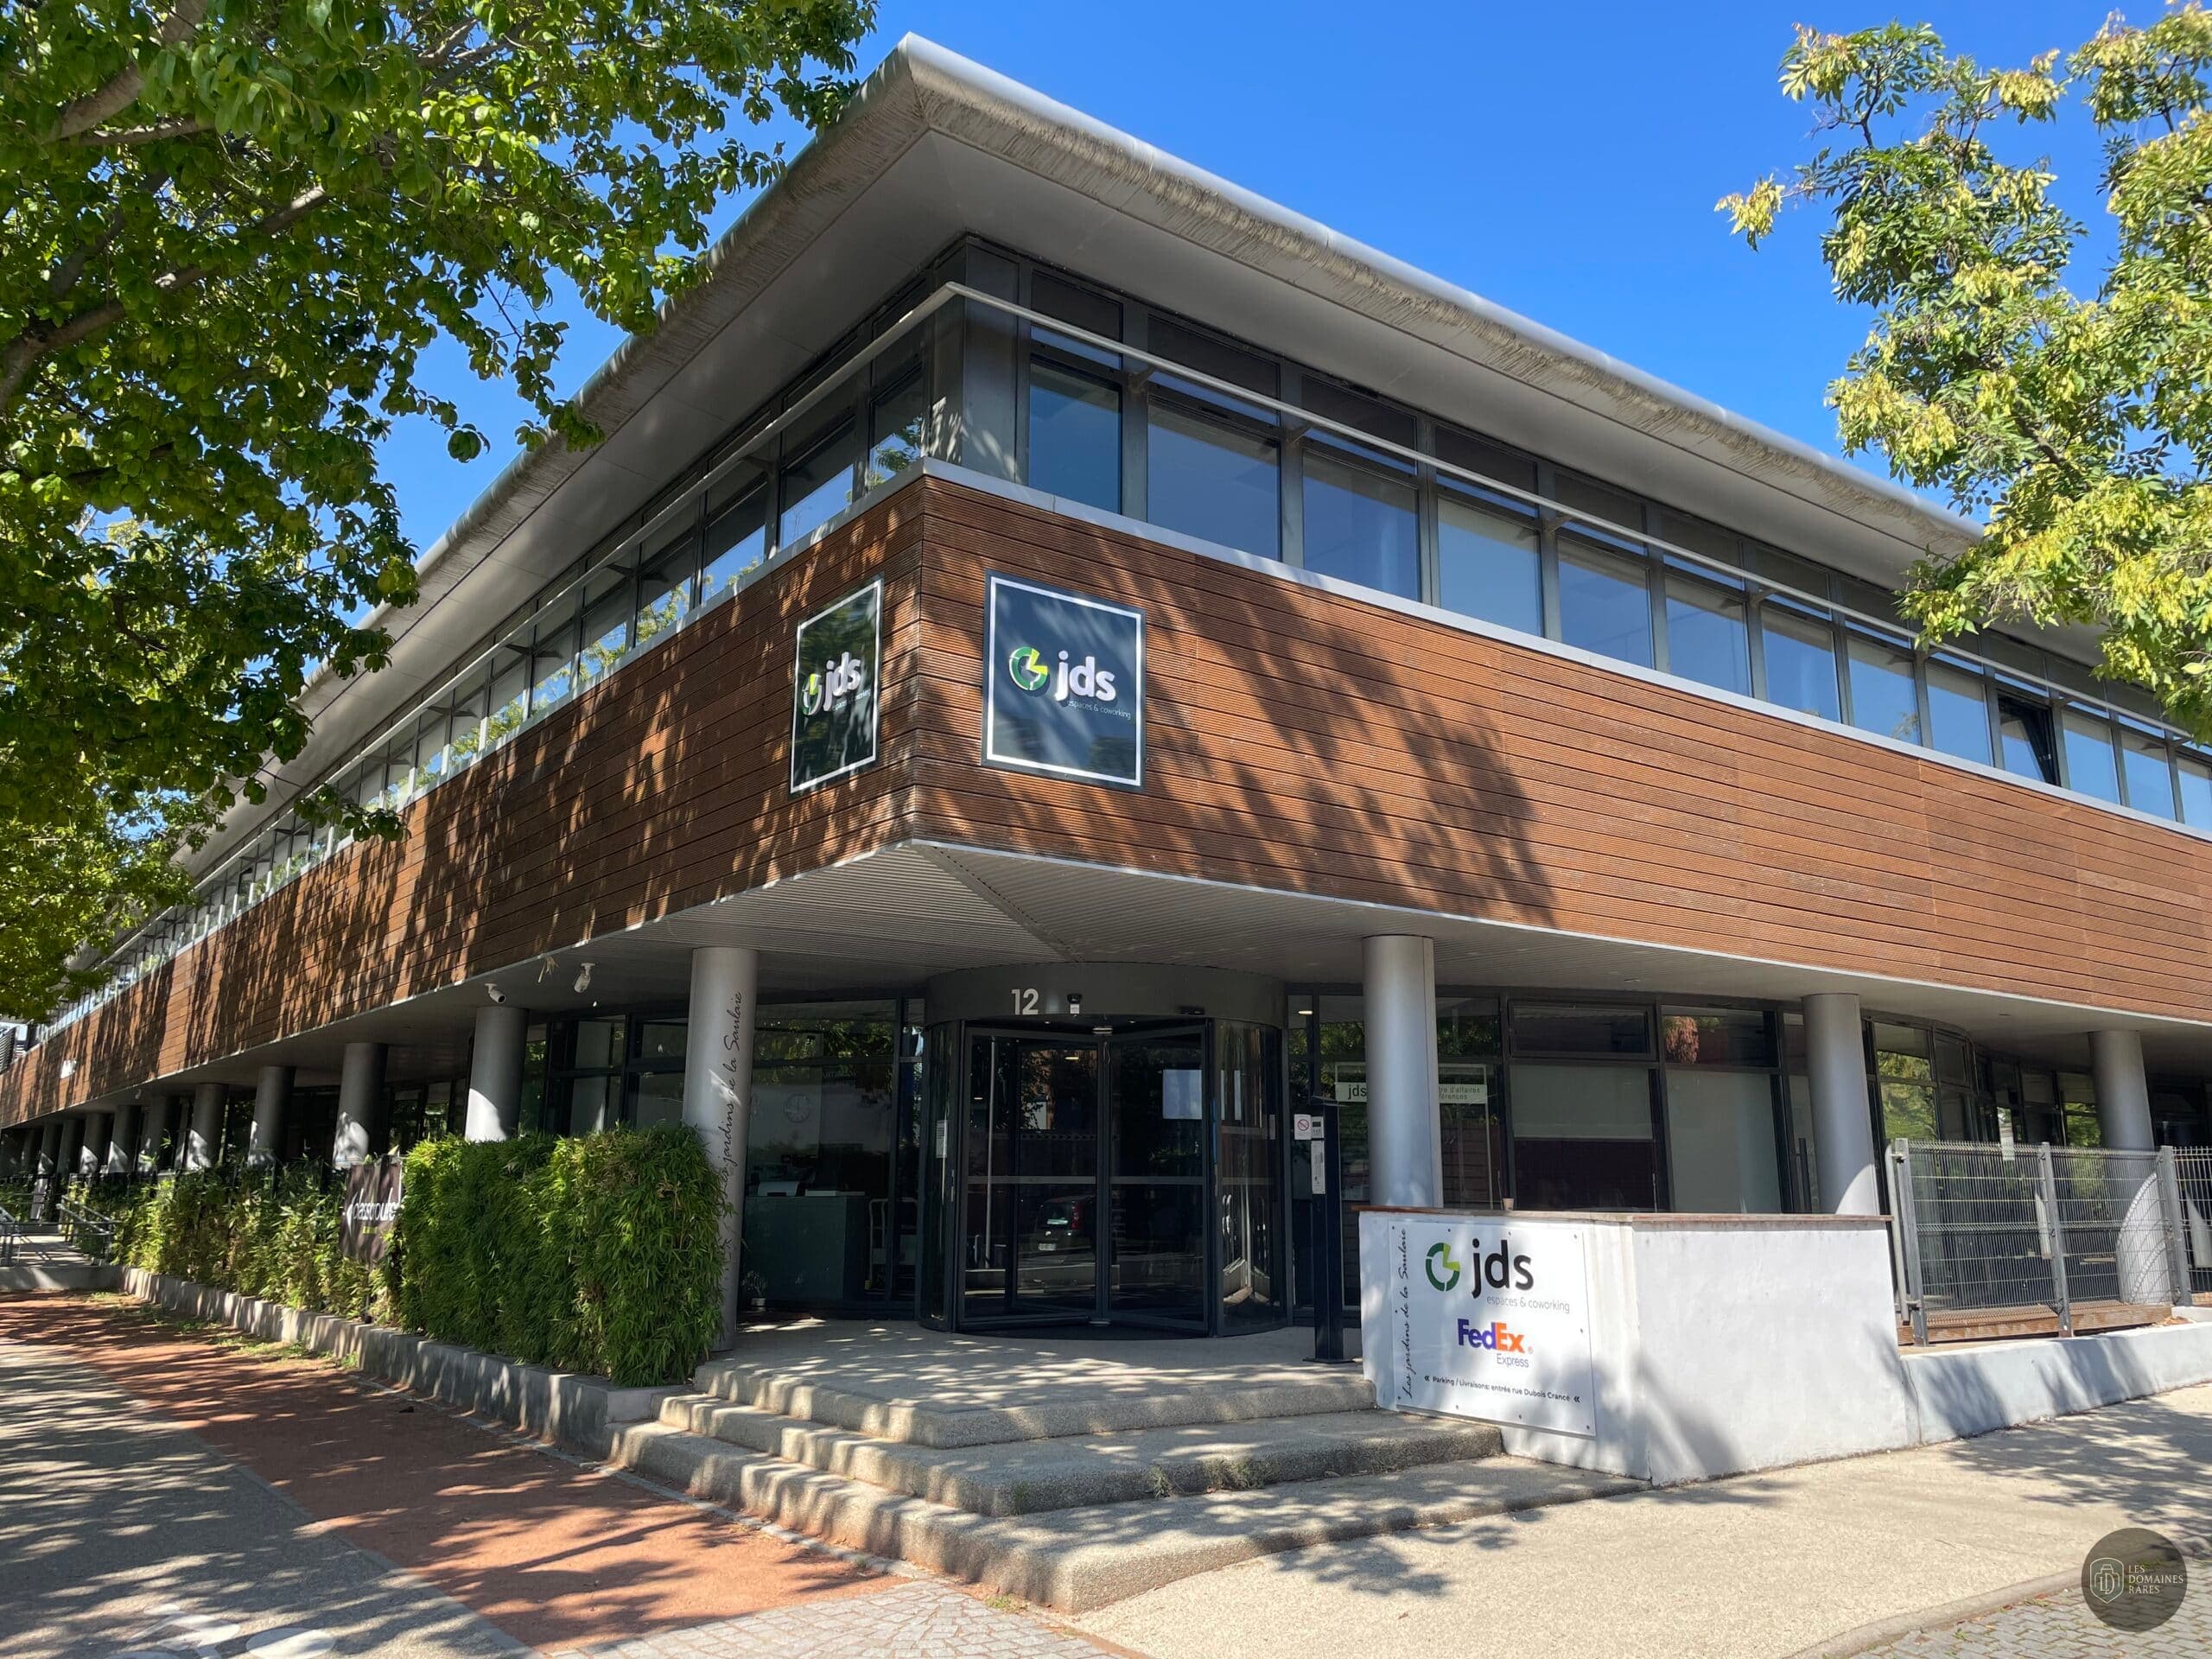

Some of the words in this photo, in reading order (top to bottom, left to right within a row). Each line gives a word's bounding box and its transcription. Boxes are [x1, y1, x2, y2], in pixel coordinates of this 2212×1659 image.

[823, 652, 861, 711] jds
[1054, 650, 1116, 702] jds
[1100, 706, 1131, 721] coworking
[1011, 988, 1039, 1016] 12
[722, 1057, 736, 1072] la
[1348, 1084, 1367, 1100] jds
[718, 1102, 738, 1167] jardins
[1471, 1237, 1535, 1299] jds
[1399, 1285, 1408, 1299] la
[1486, 1295, 1518, 1307] espaces
[1520, 1296, 1527, 1308] &
[1528, 1299, 1570, 1314] coworking
[1457, 1318, 1526, 1354] FedEx
[1496, 1352, 1529, 1368] Express
[1432, 1375, 1455, 1387] Parking
[1491, 1383, 1512, 1394] entrée
[1512, 1387, 1523, 1395] rue
[1523, 1388, 1547, 1399] Dubois
